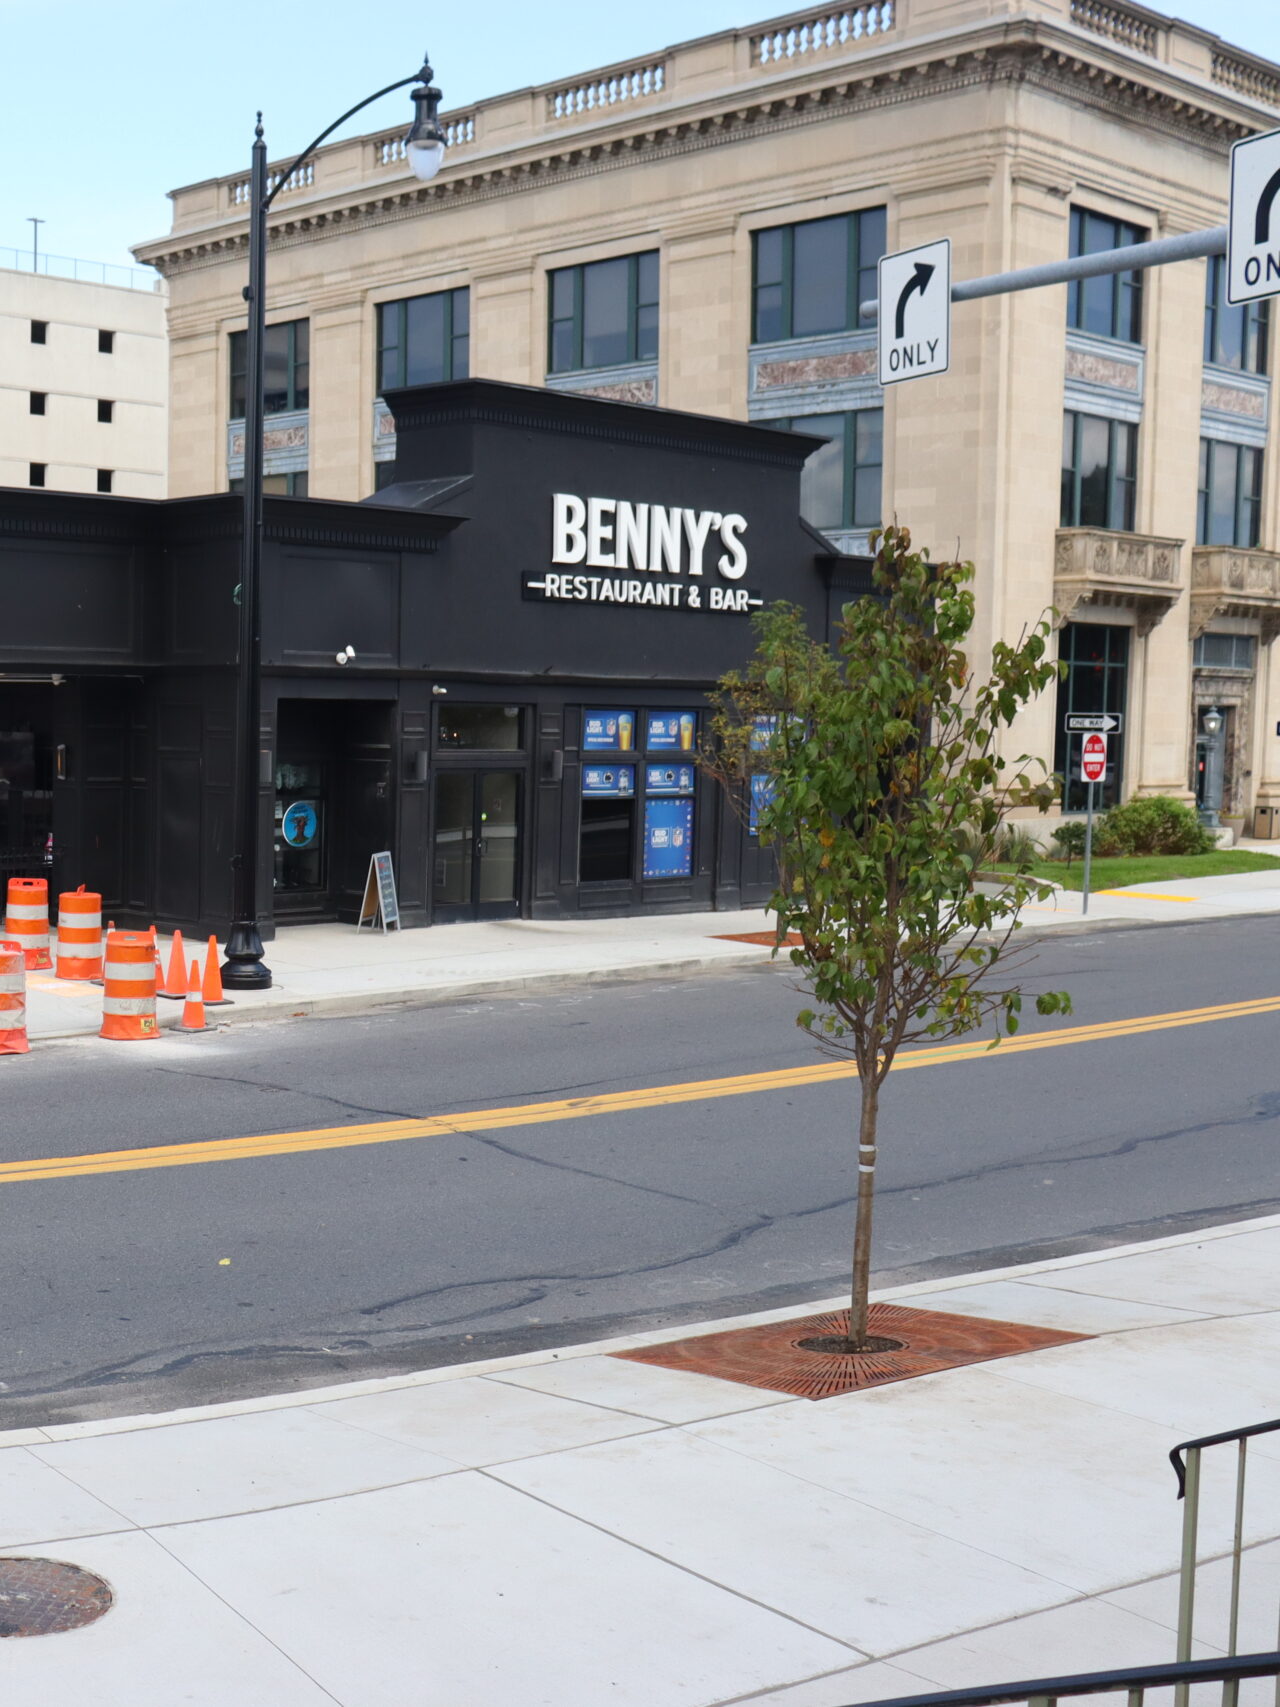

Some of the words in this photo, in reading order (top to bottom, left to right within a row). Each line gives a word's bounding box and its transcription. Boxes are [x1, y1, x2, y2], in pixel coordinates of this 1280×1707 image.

[888, 338, 940, 372] ONLY
[552, 493, 748, 580] BENNY'S
[545, 574, 683, 606] RESTAURANT
[687, 585, 701, 608] &
[710, 587, 749, 612] BAR
[1072, 719, 1085, 727] ONE
[1086, 743, 1093, 751] DO
[1094, 743, 1103, 751] NOT
[1087, 763, 1101, 772] ENTER
